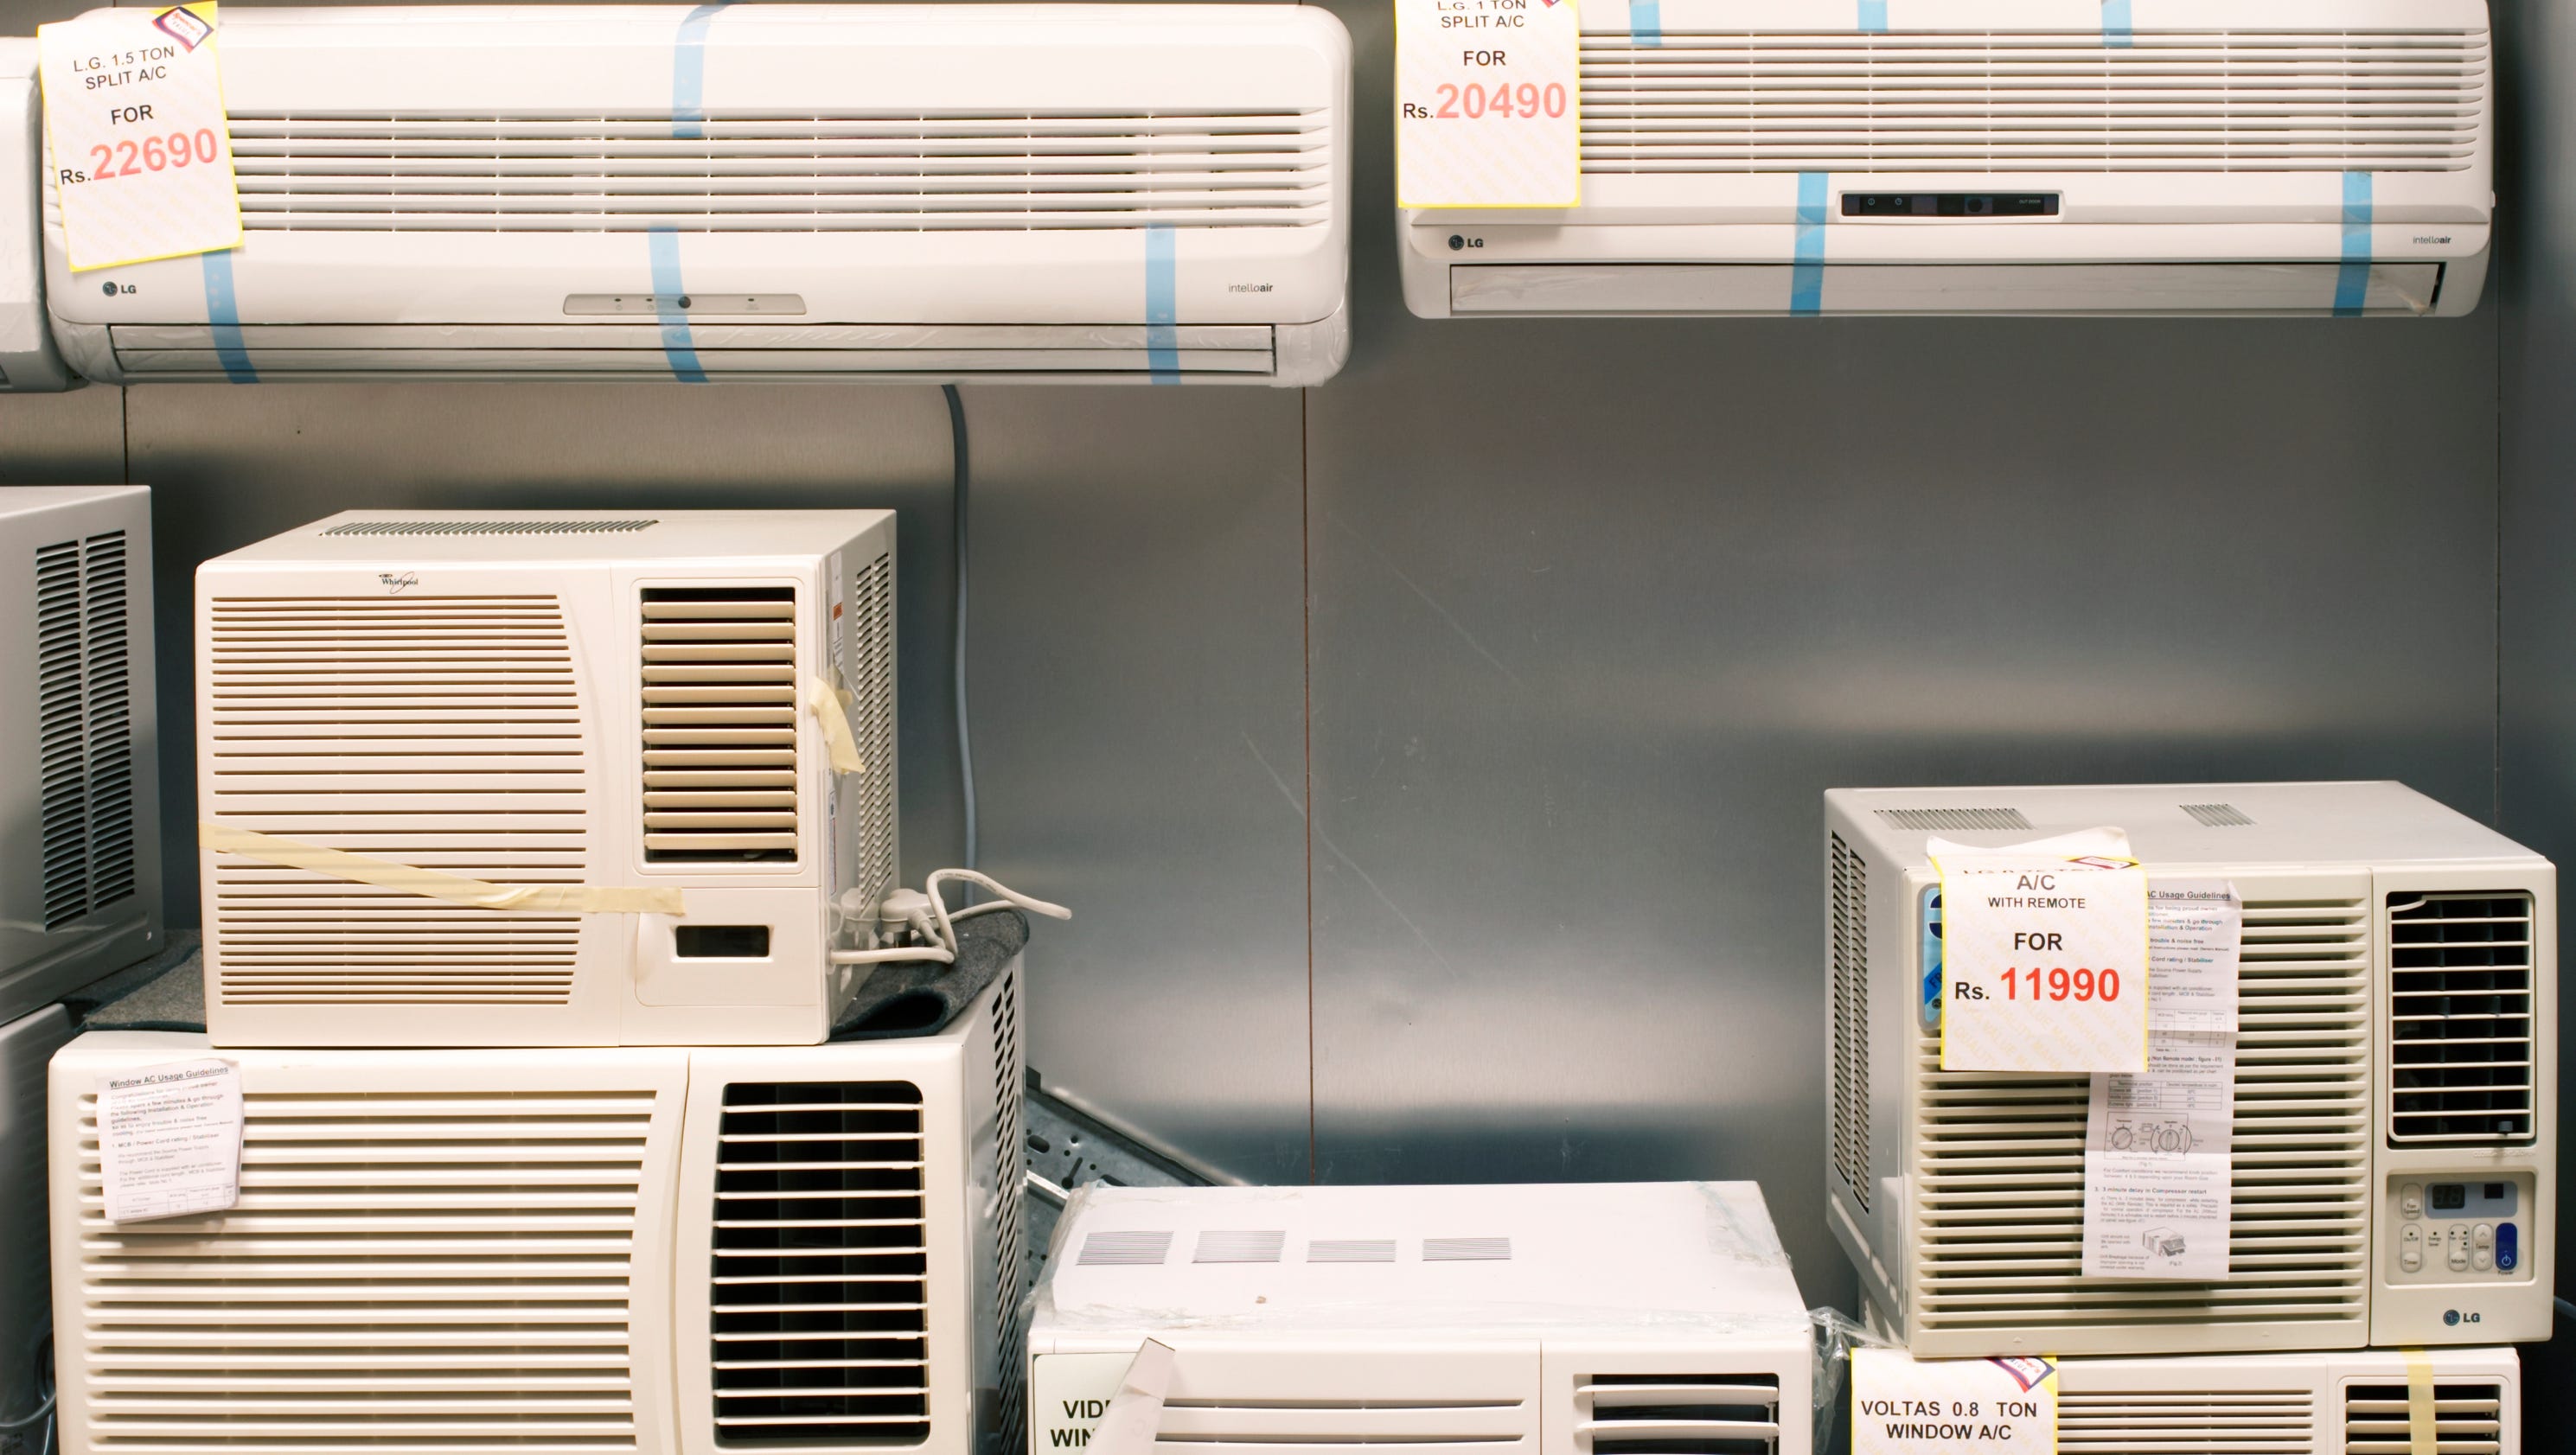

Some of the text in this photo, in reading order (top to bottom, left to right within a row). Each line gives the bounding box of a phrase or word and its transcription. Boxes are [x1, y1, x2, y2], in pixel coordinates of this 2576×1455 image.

[1491, 0, 1525, 10] TON
[1441, 16, 1524, 28] SPLIT A/C
[74, 46, 174, 72] L.G. 1.5 TON
[1464, 51, 1505, 66] FOR
[86, 66, 166, 90] SPLIT A/C
[112, 105, 153, 124] FOR
[1467, 239, 1483, 247] LG
[121, 285, 137, 294] LG
[1229, 283, 1273, 292] intelloair
[381, 578, 419, 587] Whirlpool
[2017, 875, 2055, 890] A/C
[1988, 897, 2085, 909] WITH REMOTE
[2015, 933, 2062, 950] FOR
[1955, 967, 2119, 1001] Rs. 11990
[110, 1079, 141, 1088] Window
[158, 1073, 183, 1082] Usage
[186, 1067, 228, 1077] Guidelines
[2464, 1313, 2480, 1323] LG
[1861, 1401, 2036, 1417] VOLTAS 0.8 TON
[1886, 1424, 2011, 1439] WINDOW A/C
